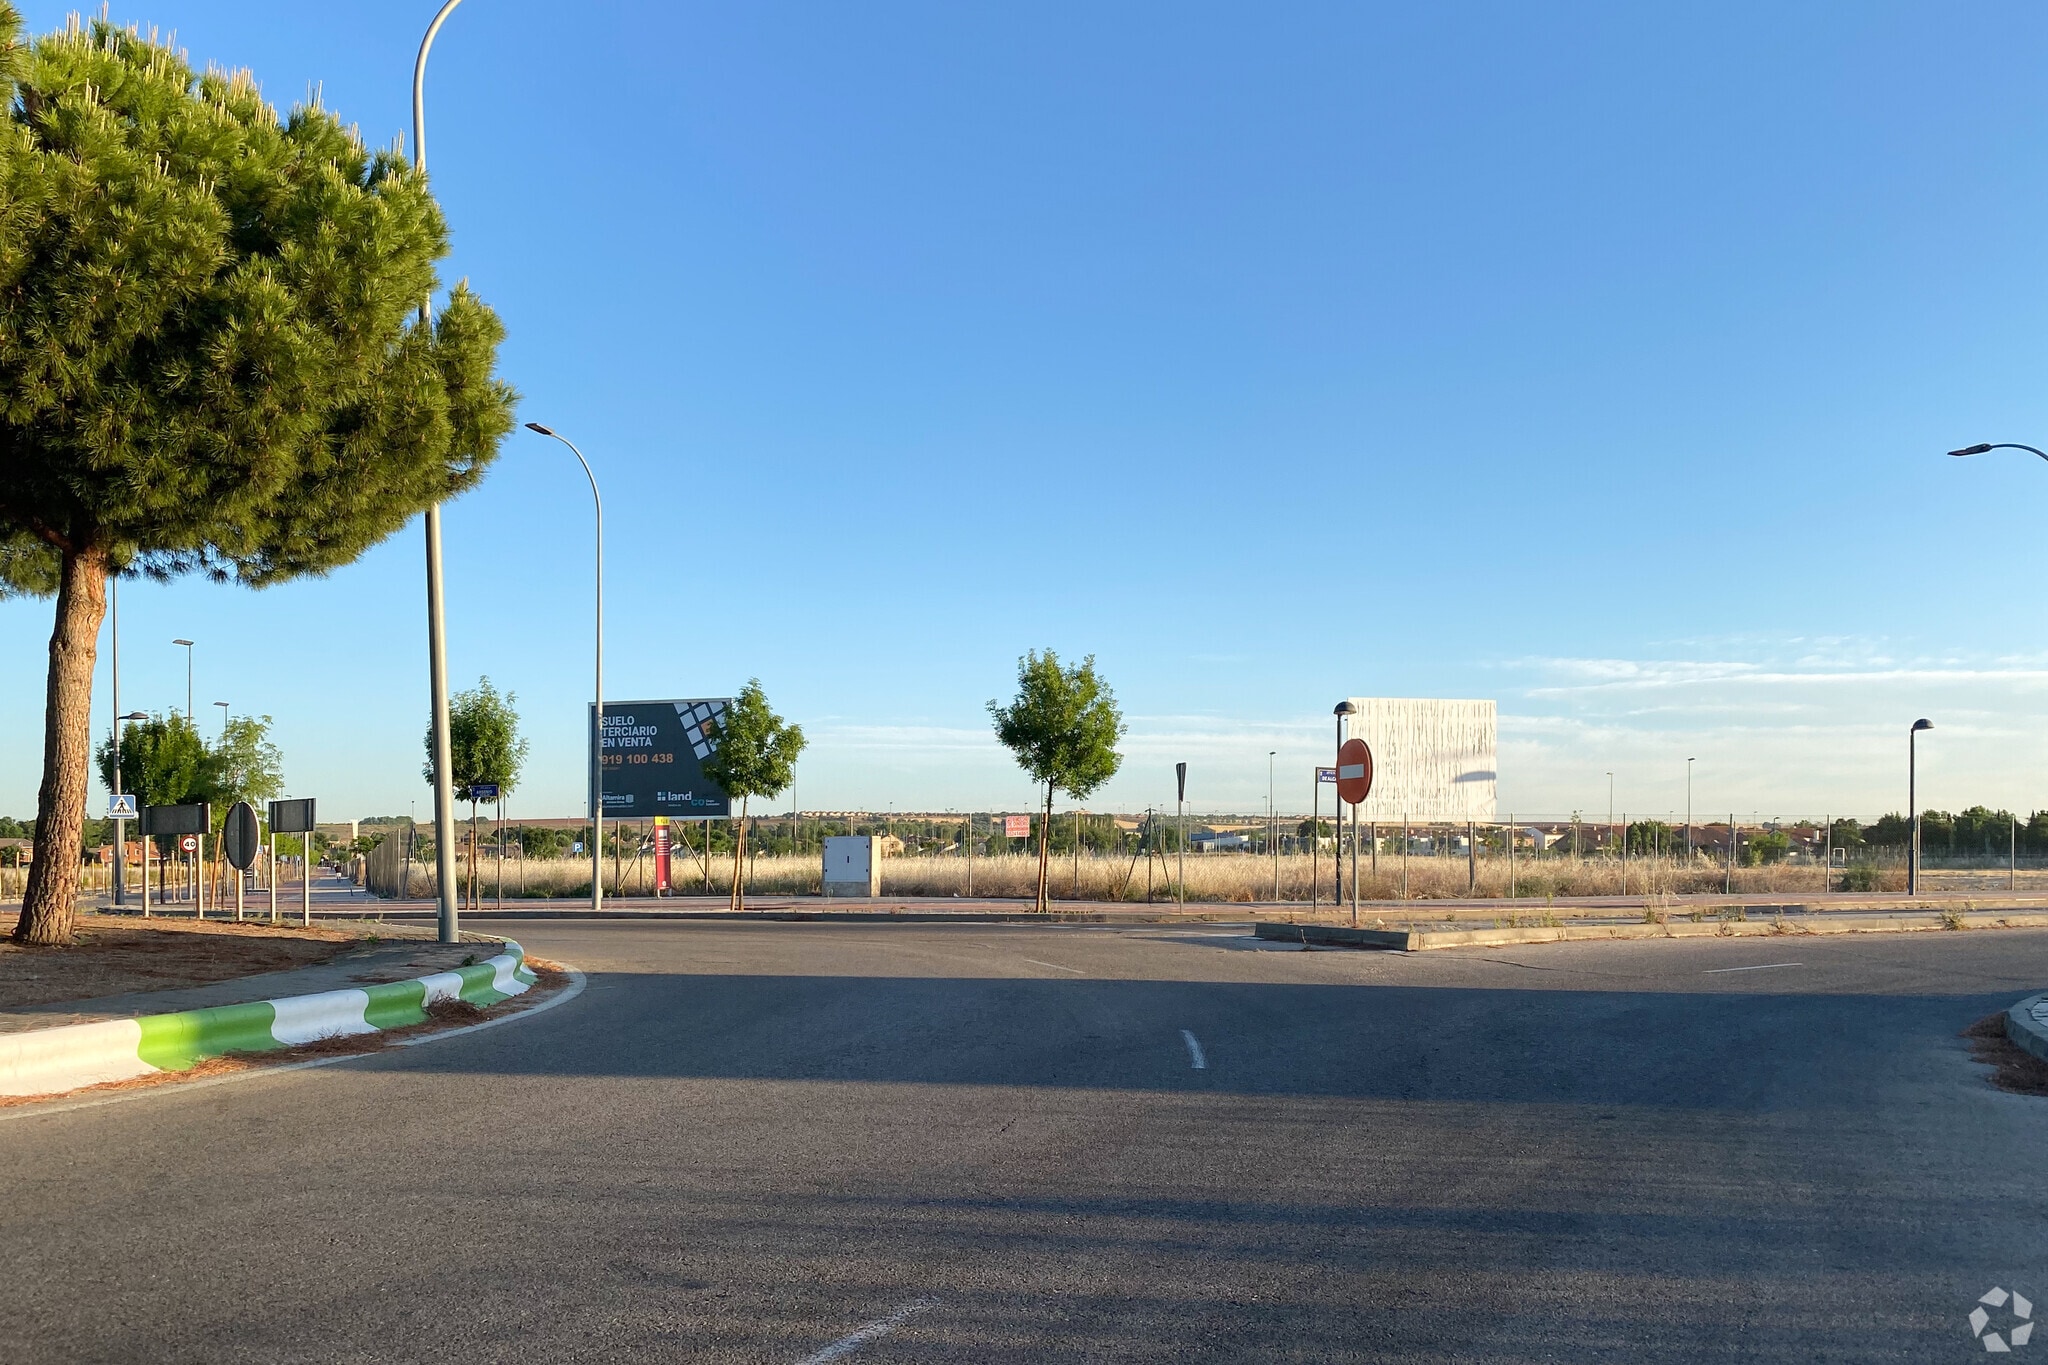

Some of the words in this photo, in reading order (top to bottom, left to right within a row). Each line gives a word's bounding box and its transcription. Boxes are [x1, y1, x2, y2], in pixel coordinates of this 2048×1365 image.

[602, 715, 635, 726] SUELO
[602, 725, 658, 737] TERCIARIO
[602, 738, 615, 748] EN
[617, 736, 653, 747] VENTA
[602, 754, 623, 765] 919
[626, 754, 648, 764] 100
[651, 753, 674, 763] 438
[668, 791, 692, 801] land
[574, 843, 581, 852] P
